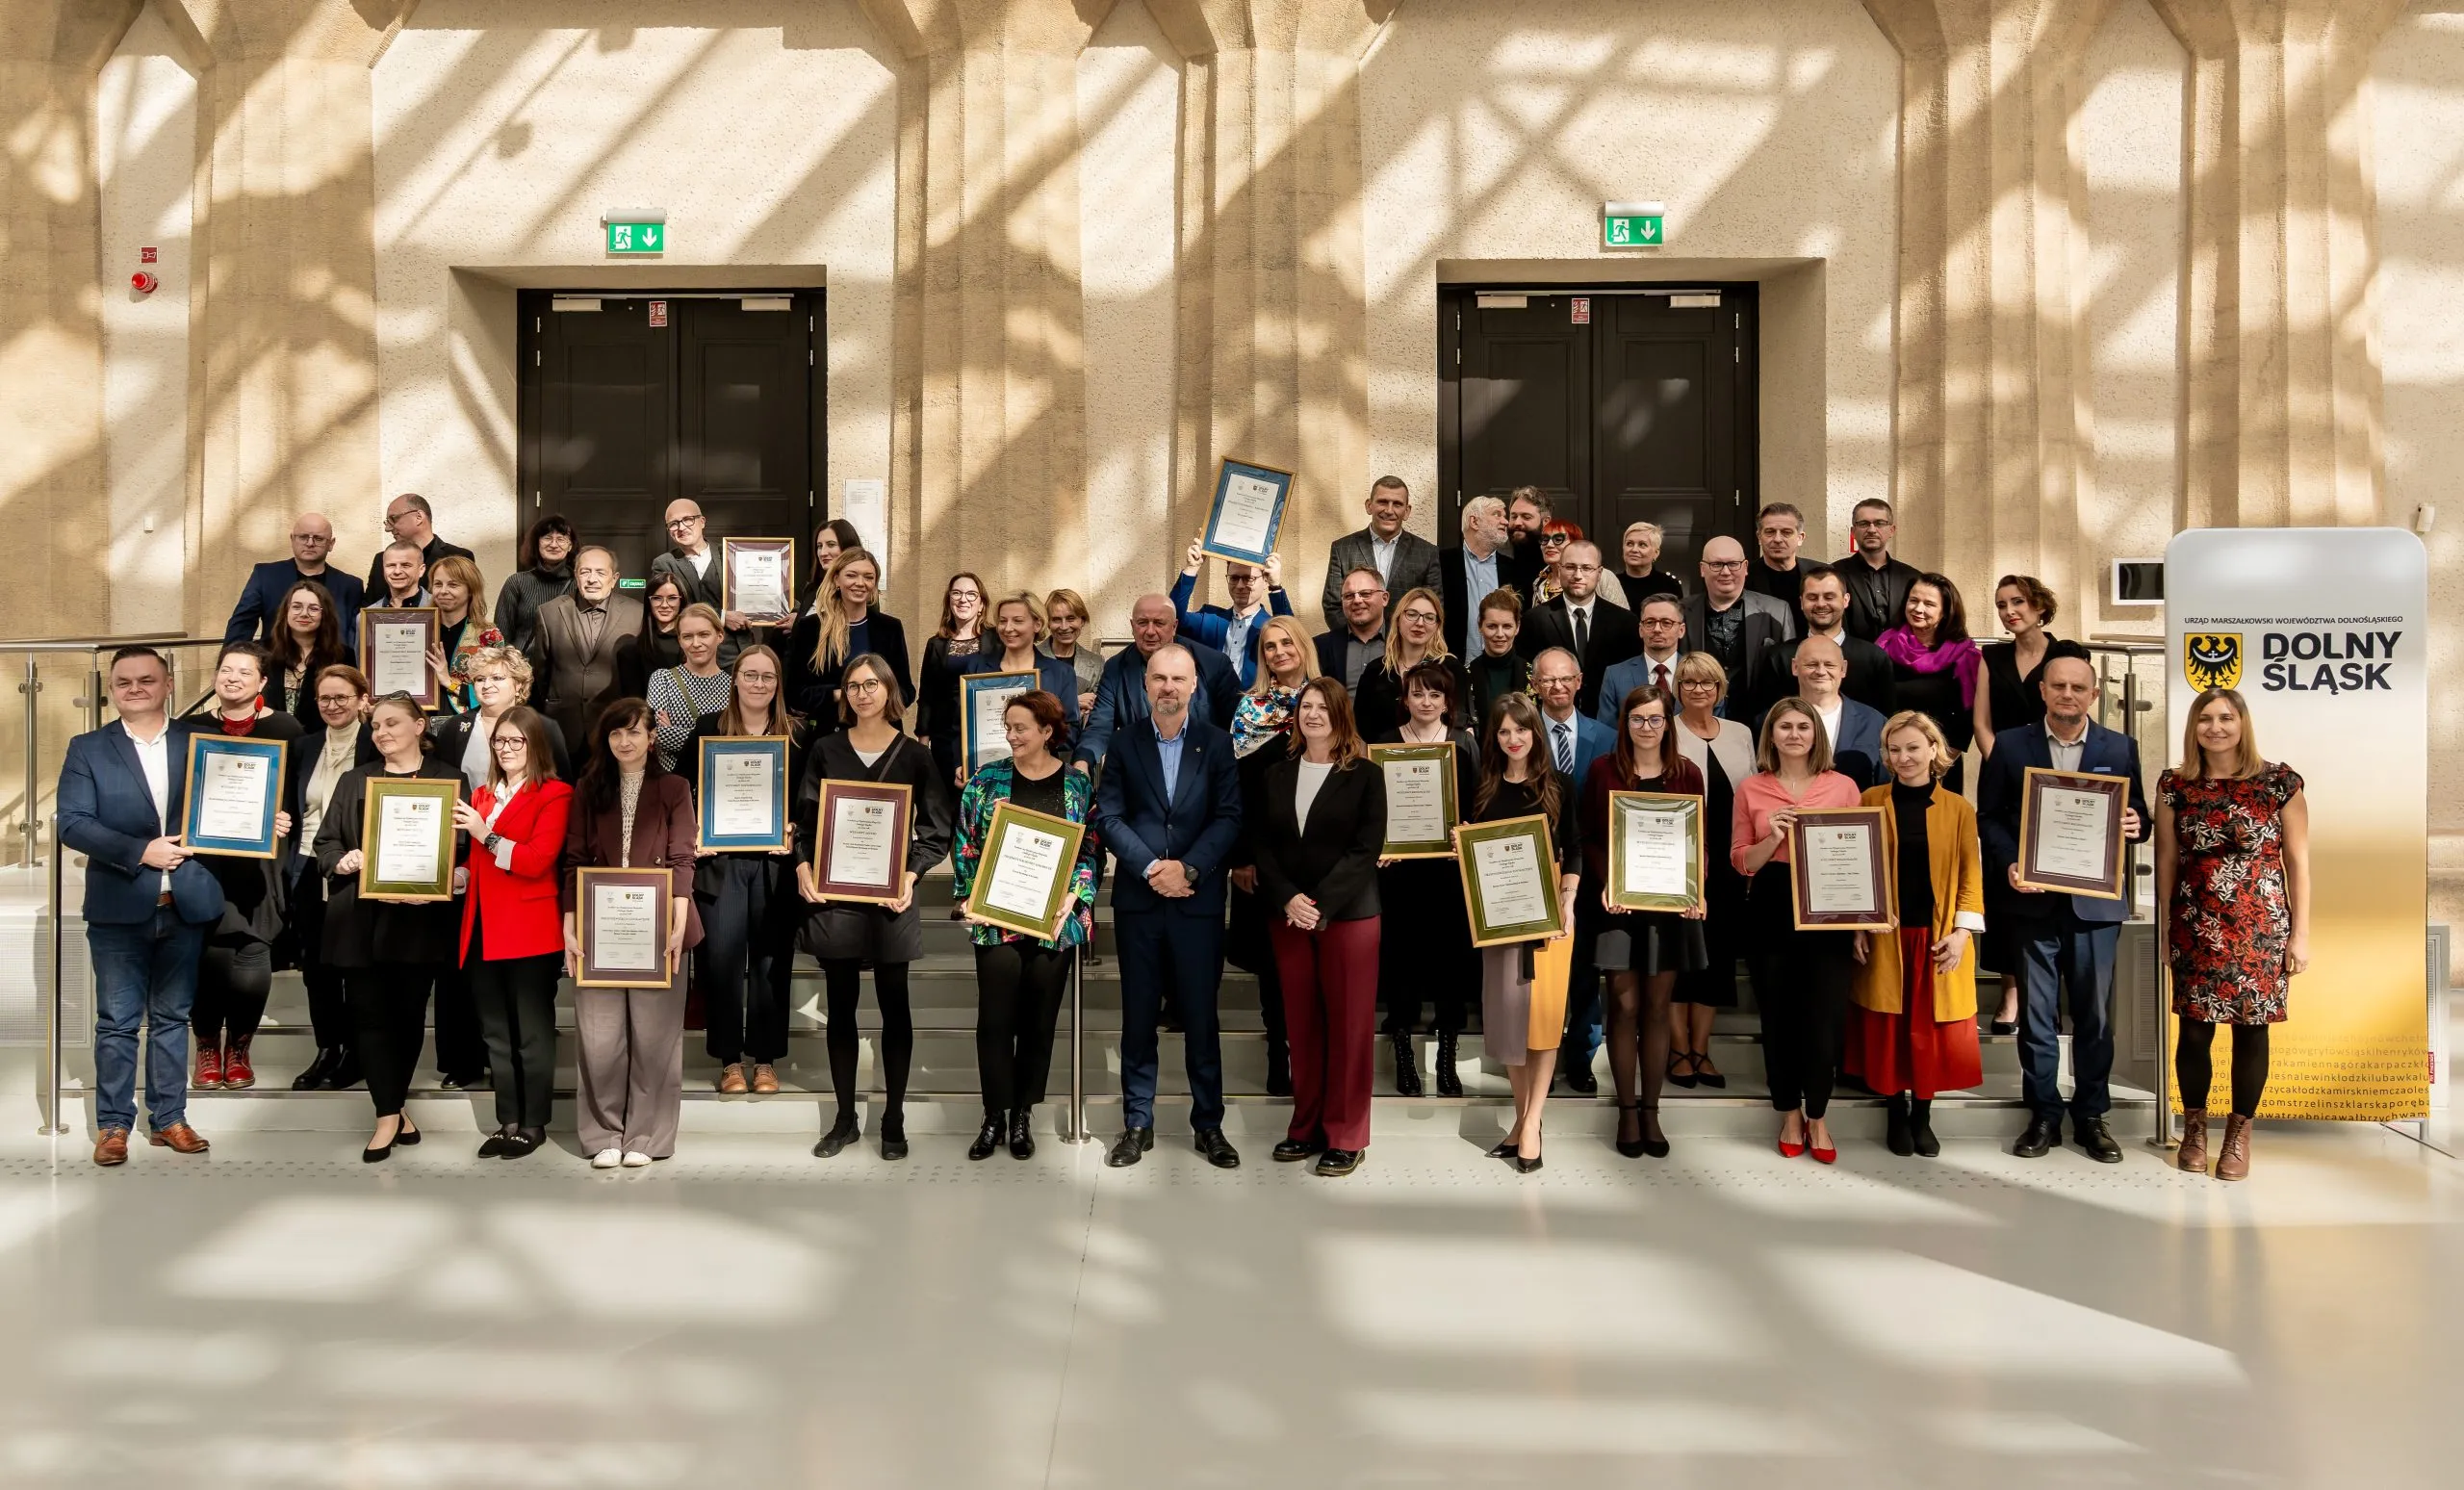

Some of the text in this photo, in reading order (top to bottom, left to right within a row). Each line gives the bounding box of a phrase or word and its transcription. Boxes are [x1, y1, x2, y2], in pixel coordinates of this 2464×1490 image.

[2184, 617, 2209, 626] URZĄD
[2275, 616, 2336, 625] WOJEWÓDZTWA
[2338, 615, 2403, 625] DOLNOŚLĄSKIEGO
[2262, 630, 2403, 660] DOLNY
[2262, 657, 2394, 695] ŚLĄSK
